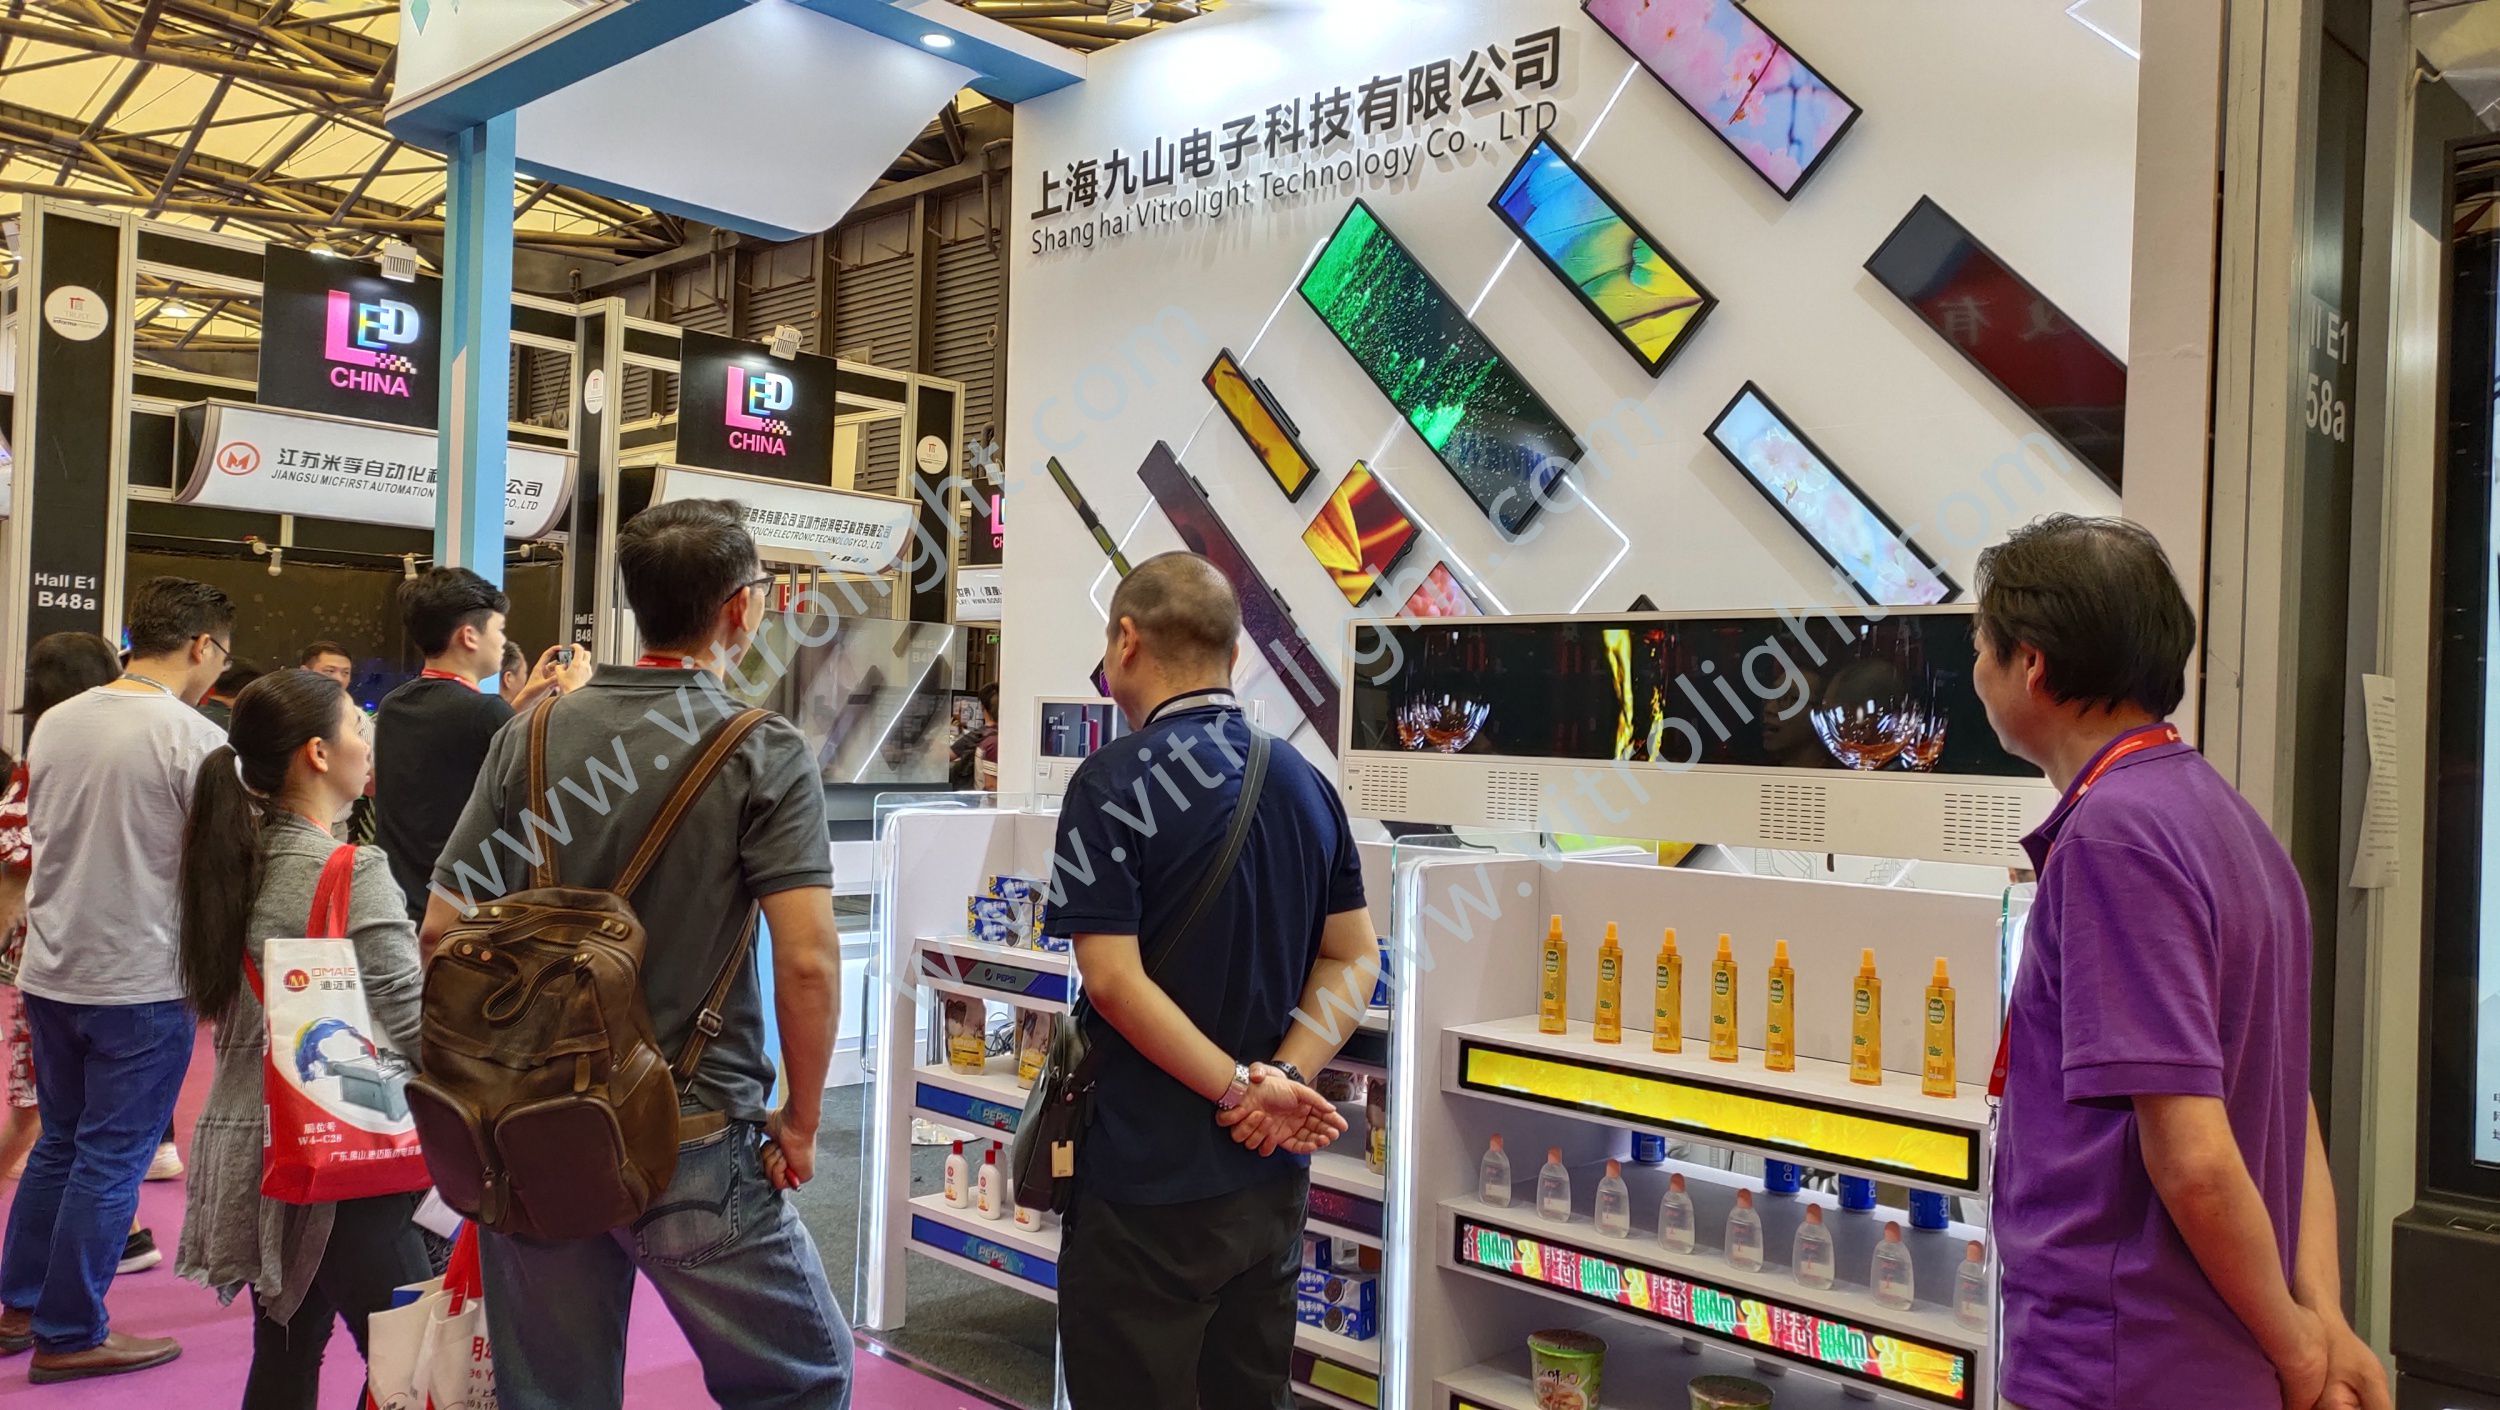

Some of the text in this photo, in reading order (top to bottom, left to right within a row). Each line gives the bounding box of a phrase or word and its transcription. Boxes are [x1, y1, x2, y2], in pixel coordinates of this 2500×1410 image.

[1030, 26, 1562, 220] 上海九山电子科技有限公司
[1137, 180, 1251, 226] Vitrolight
[1258, 141, 1419, 200] Technology
[1426, 129, 1488, 158] Co.,
[1499, 100, 1559, 142] LTD
[325, 289, 420, 367] LED
[2327, 311, 2349, 364] E1
[330, 366, 410, 398] CHINA
[725, 366, 794, 431] LED
[2306, 372, 2346, 443] 58a
[728, 431, 787, 457] CHINA
[271, 469, 319, 485] JIANGSU
[320, 475, 369, 491] MICFIRST
[370, 481, 435, 499] AUTOMATION
[34, 572, 96, 590] Hall E1
[38, 591, 96, 610] B48a
[575, 629, 592, 642] B48
[996, 973, 1017, 985] PEPSI
[983, 1108, 1012, 1124] PEPSI
[978, 1244, 1008, 1264] PEPSI
